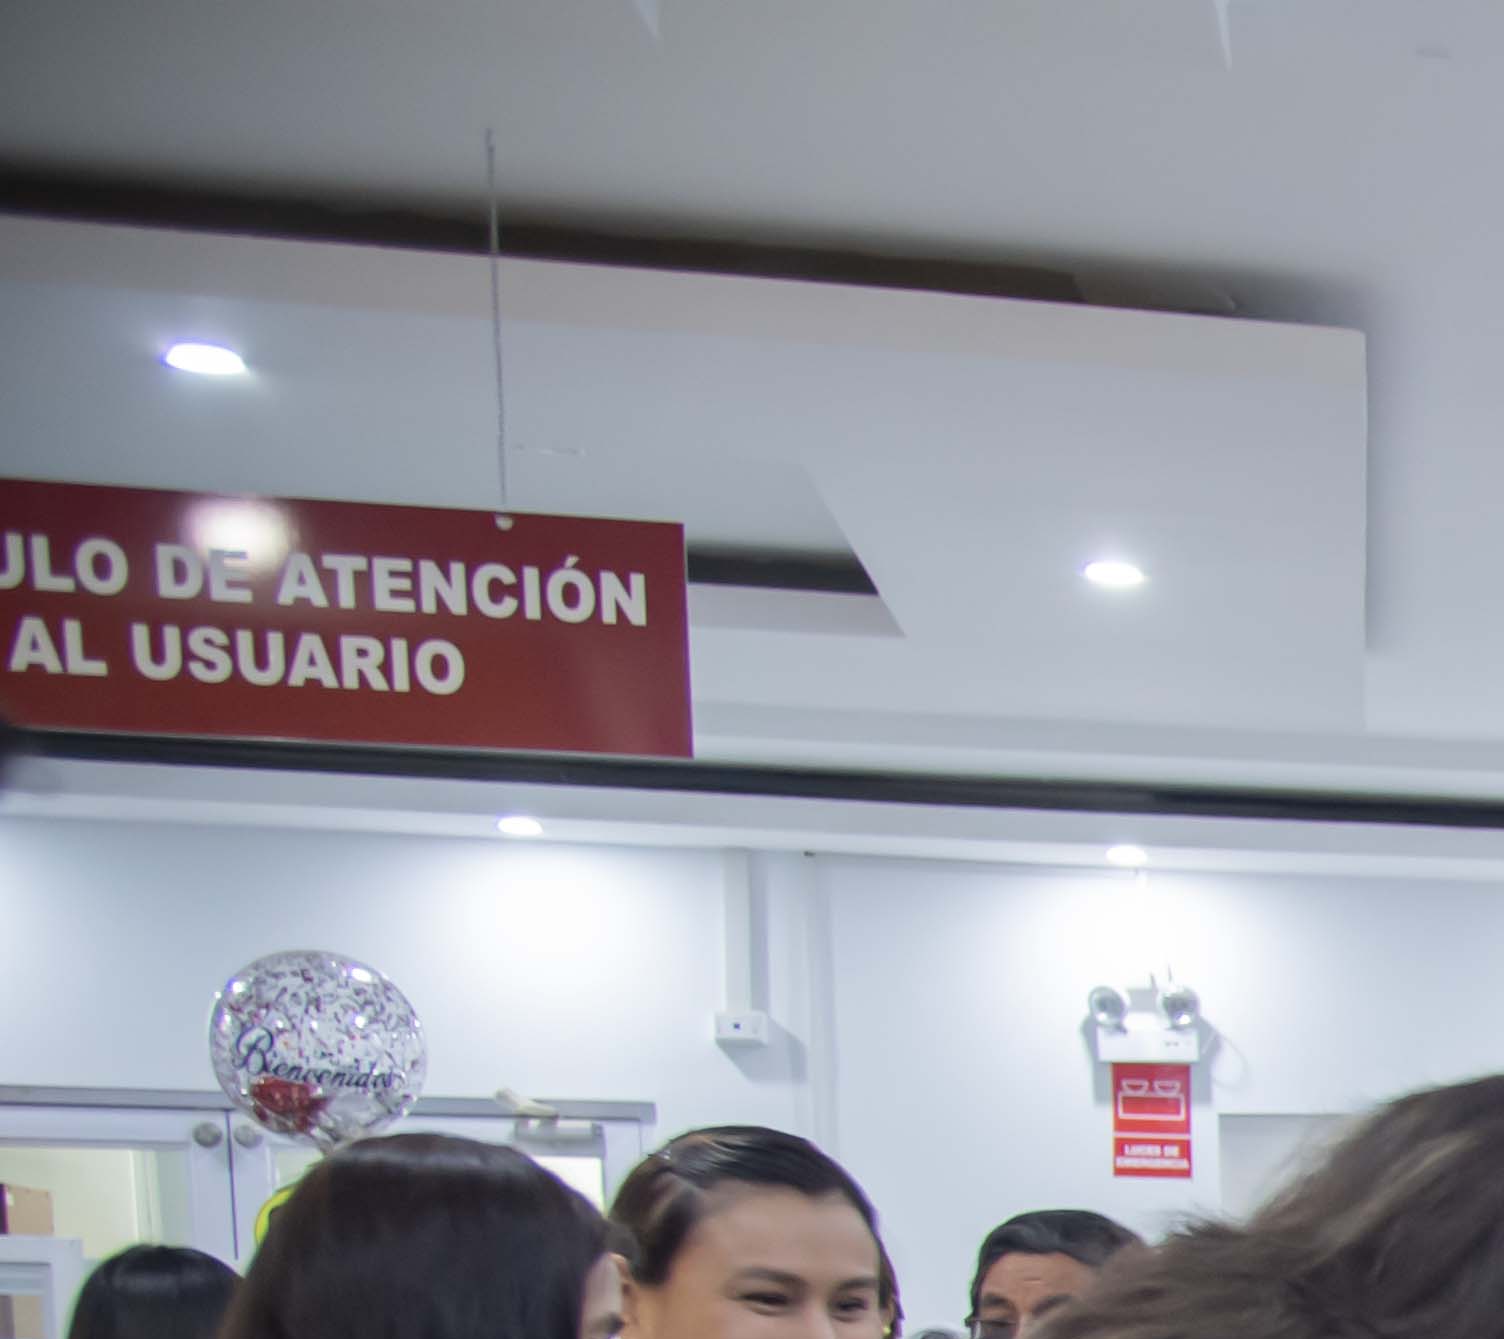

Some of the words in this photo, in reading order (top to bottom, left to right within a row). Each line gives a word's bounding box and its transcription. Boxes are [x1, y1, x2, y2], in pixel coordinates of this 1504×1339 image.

[154, 541, 254, 602] DE
[278, 552, 647, 627] ATENCIÓN
[9, 616, 109, 677] AL
[131, 623, 465, 695] USUARIO
